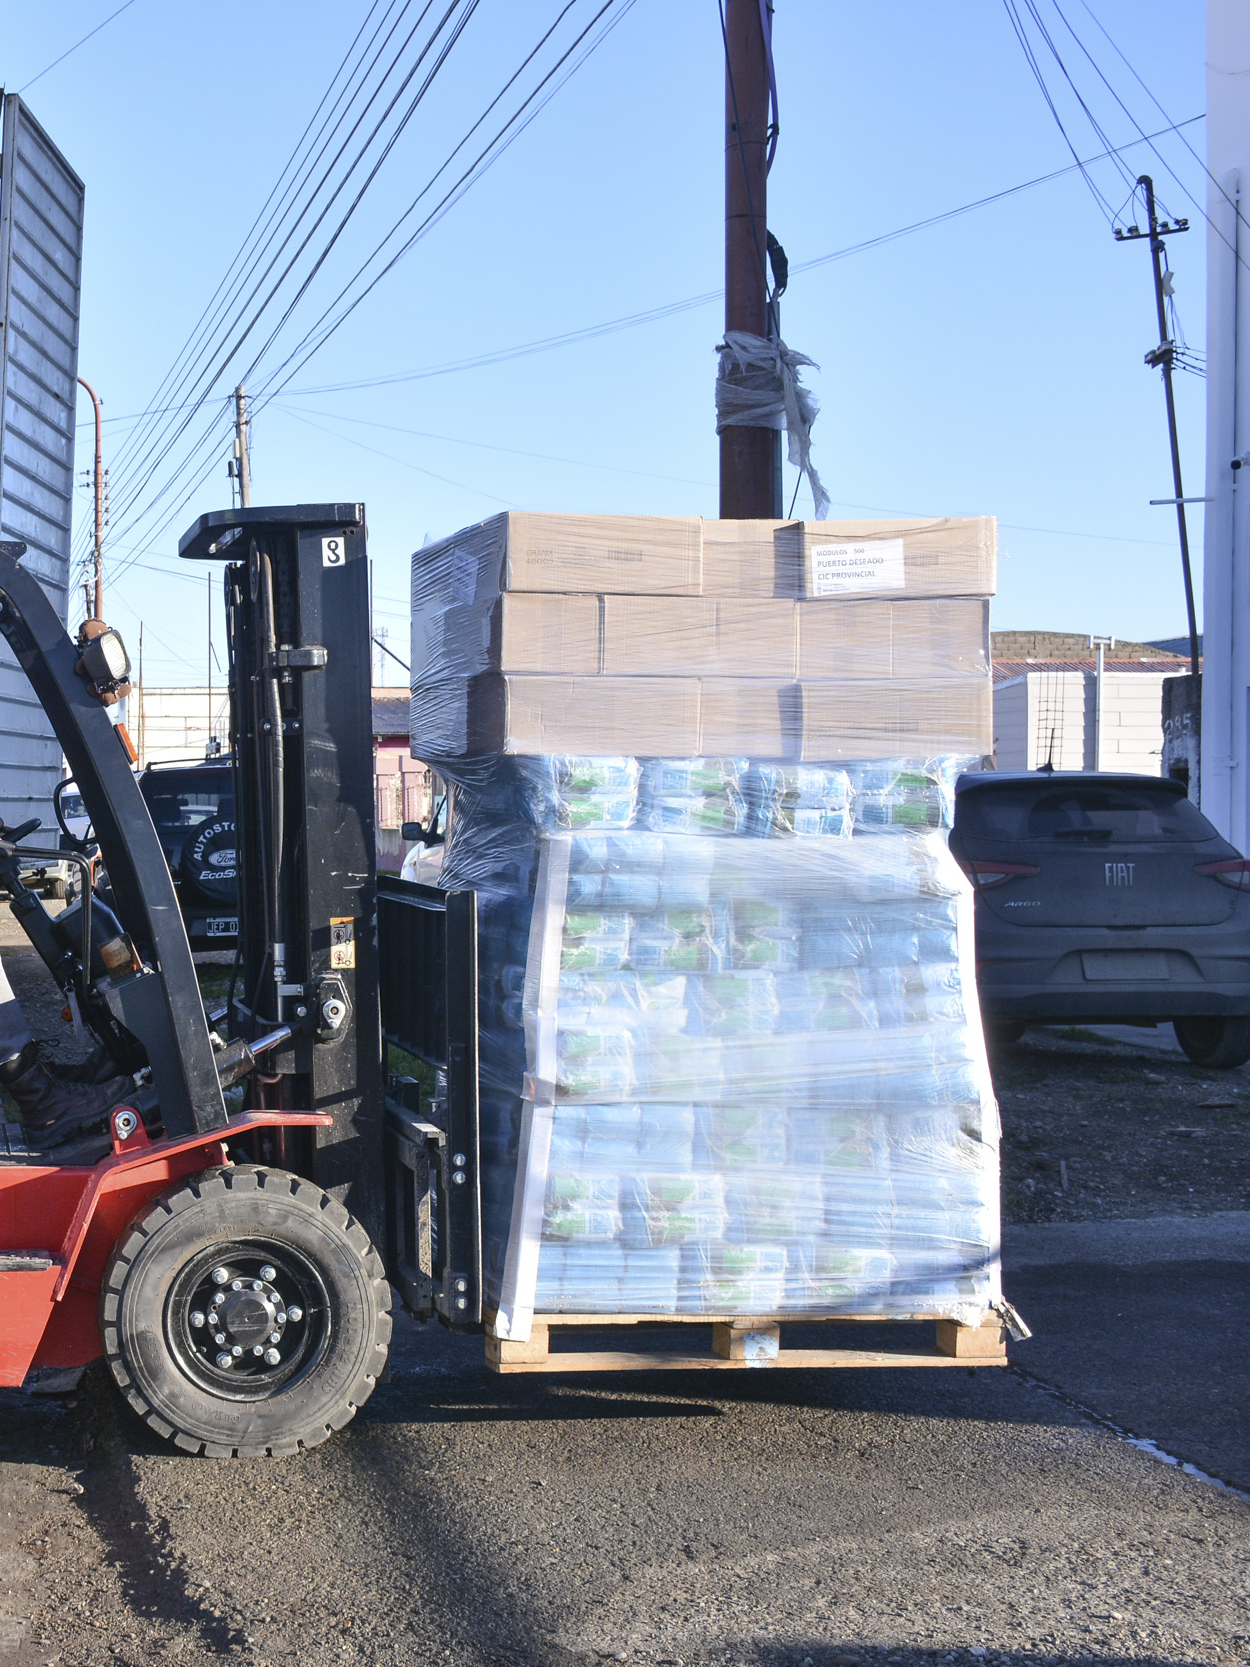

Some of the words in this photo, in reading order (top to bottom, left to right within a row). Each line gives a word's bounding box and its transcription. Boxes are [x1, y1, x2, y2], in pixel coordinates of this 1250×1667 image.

[817, 560, 848, 568] PUERTO
[849, 557, 884, 566] DESEADO
[832, 570, 876, 580] PROVINCIAL
[217, 852, 236, 864] For
[1104, 863, 1135, 886] FIAT
[208, 922, 224, 932] JEP
